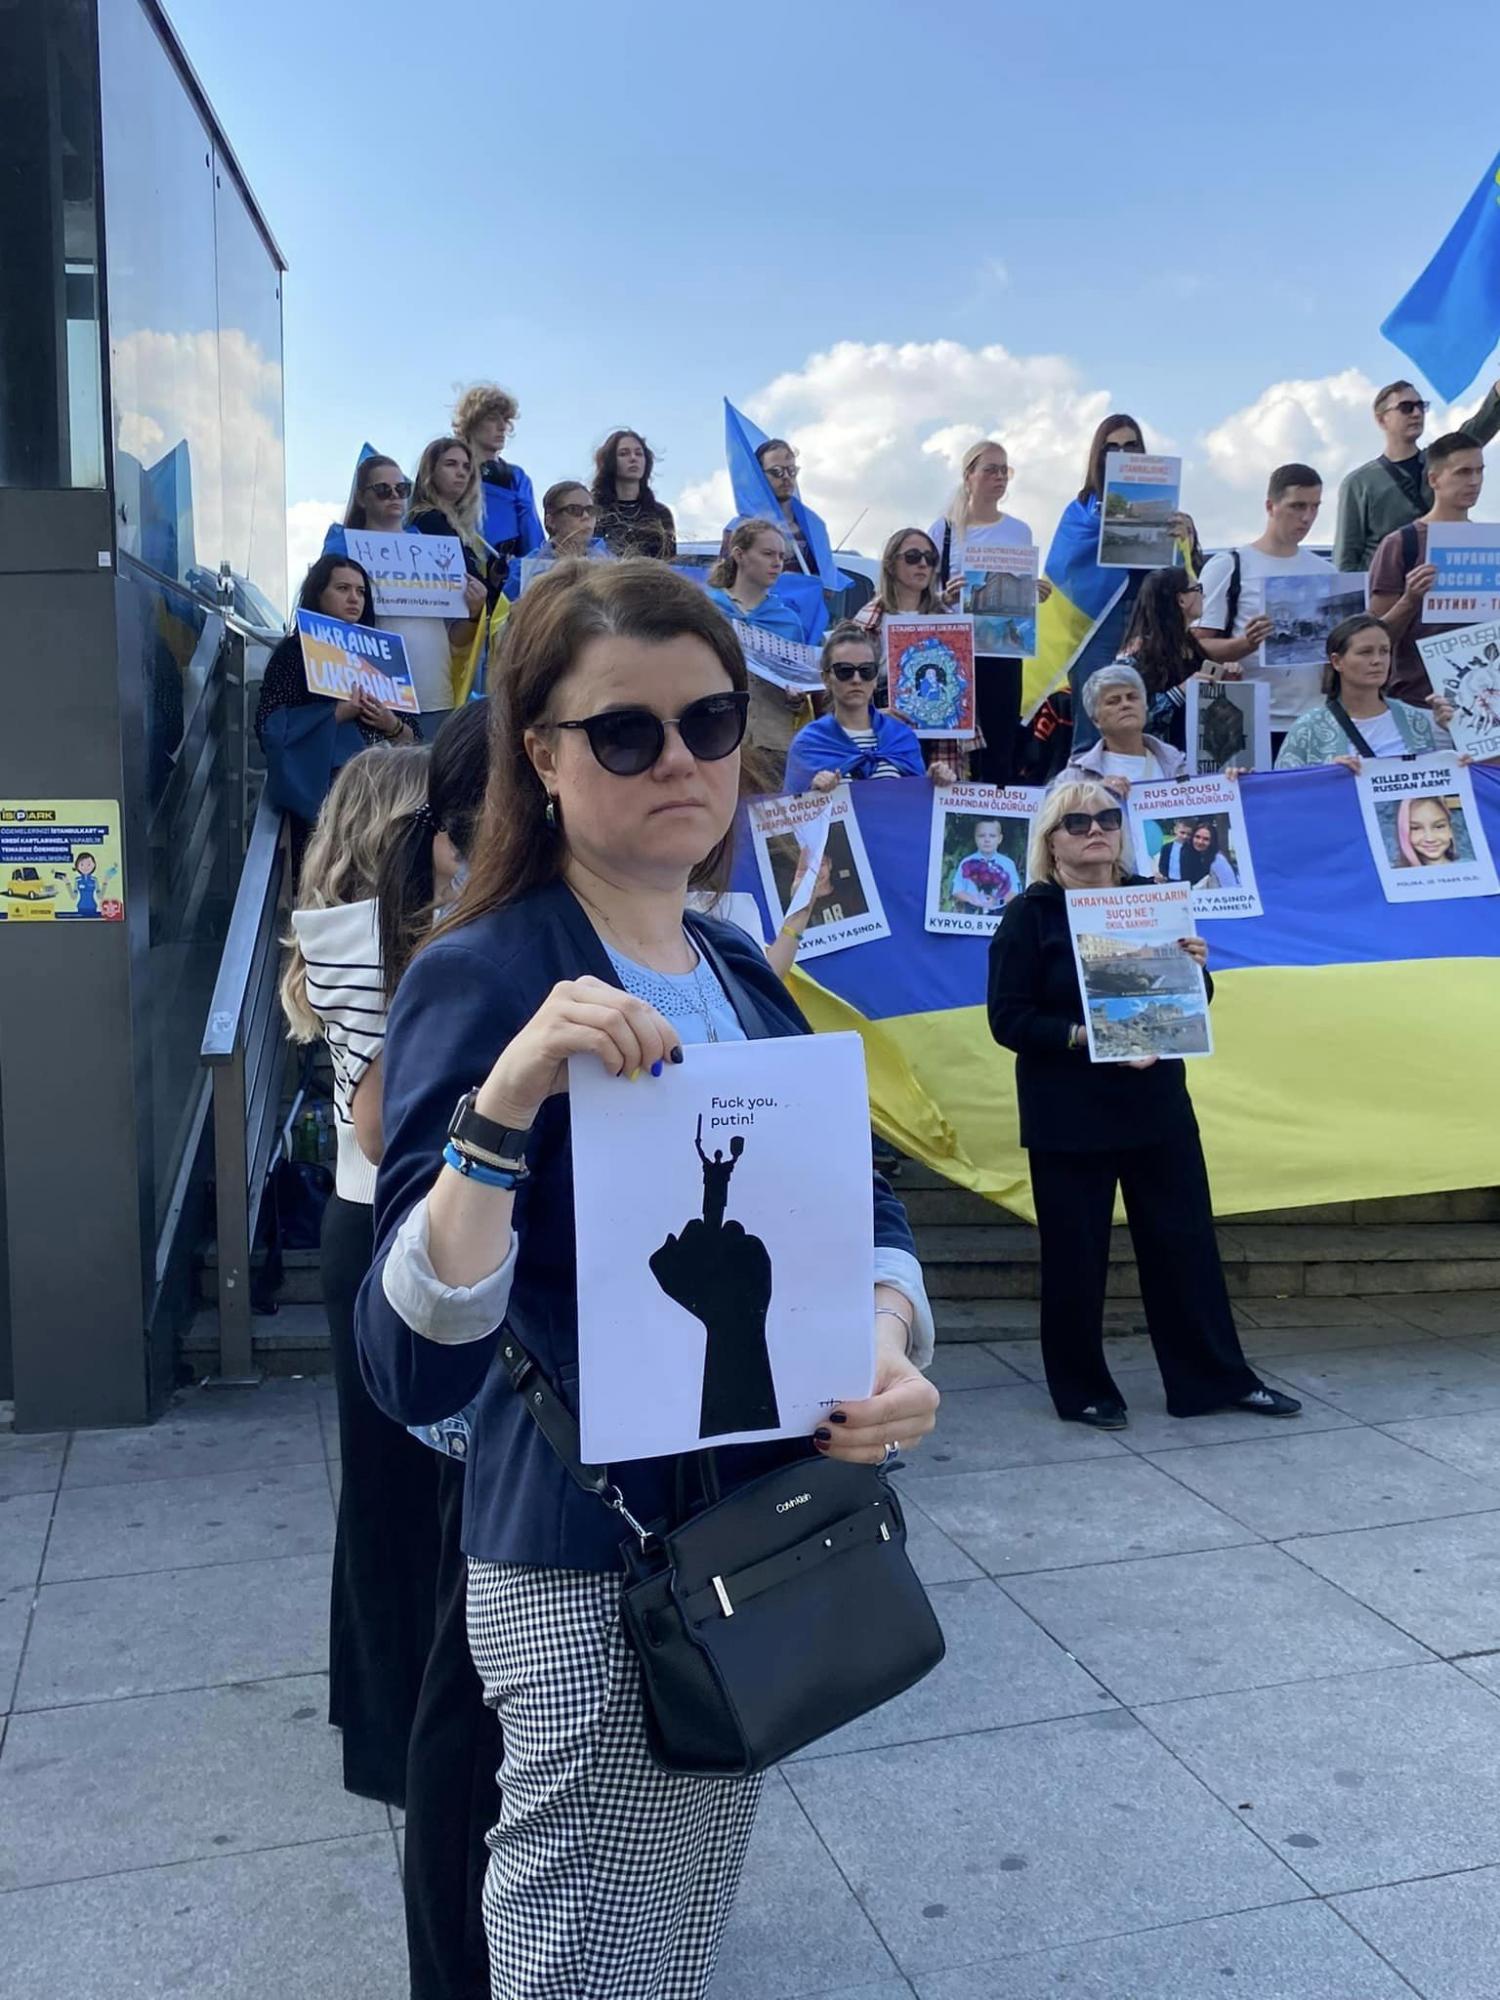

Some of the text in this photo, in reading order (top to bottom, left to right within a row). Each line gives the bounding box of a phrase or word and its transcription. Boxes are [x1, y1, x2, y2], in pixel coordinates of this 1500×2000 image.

[355, 540, 422, 570] Help
[369, 570, 462, 590] KRAINE
[891, 624, 970, 632] STAND WITH UKRAINE
[309, 622, 392, 660] UKRAINE
[1423, 637, 1458, 658] STOP
[310, 659, 413, 708] UKRAINE
[1371, 768, 1451, 785] KILLED BY THE
[952, 787, 1027, 800] RUS ORDUSU
[1373, 778, 1451, 793] RUSSIAN ARMY
[1133, 791, 1234, 811] TARAFINDAN ÖLDÜRÜLDÜ
[1144, 789, 1168, 800] RUS
[939, 797, 1039, 813] TARAFINDAN ÖLDÜRÜLDÜ
[1126, 890, 1188, 906] ÇOCUKLARIN
[929, 918, 974, 930] KYRYLO,
[711, 1097, 744, 1109] Fuck
[711, 1112, 754, 1128] putin!
